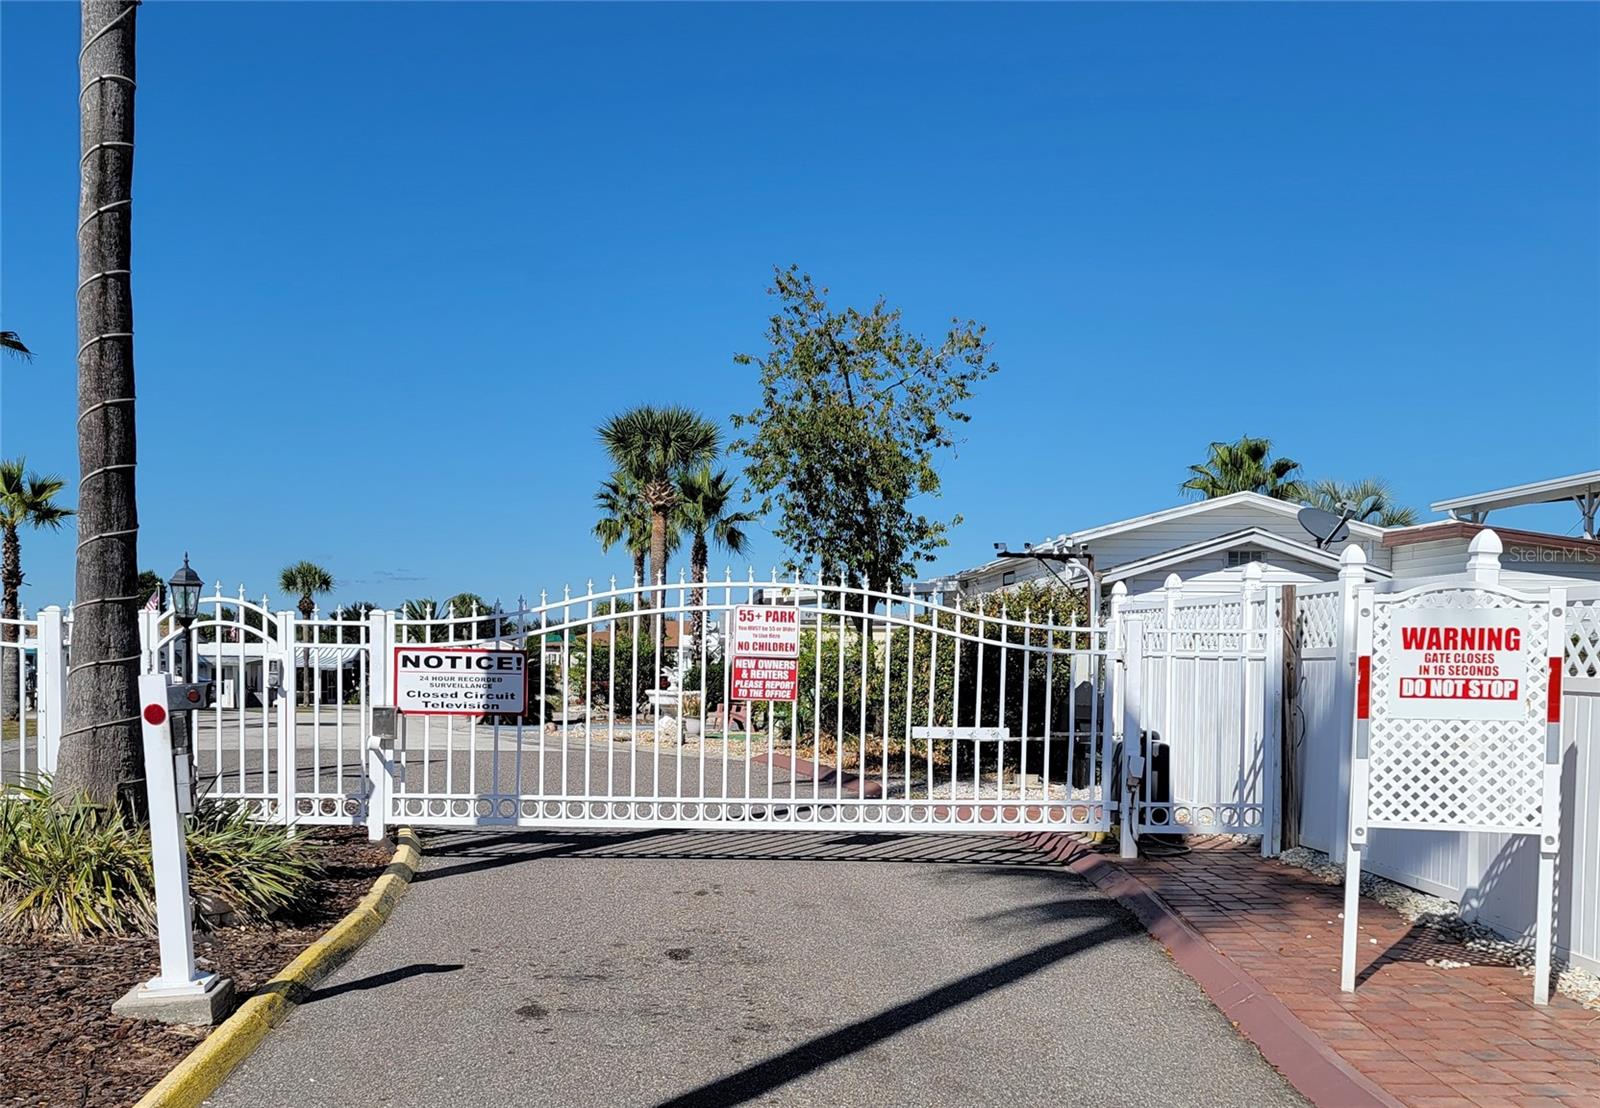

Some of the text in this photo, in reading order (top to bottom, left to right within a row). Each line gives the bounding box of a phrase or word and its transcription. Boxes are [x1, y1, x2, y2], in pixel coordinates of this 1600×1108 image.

[739, 610, 762, 622] 55+
[765, 610, 795, 623] PARK
[1402, 627, 1520, 651] WARNING
[738, 641, 796, 652] NO CHILDREN
[402, 655, 522, 670] NOTICE!
[1424, 652, 1495, 664] GATE CLOSES
[736, 659, 796, 670] NEW OWNERS
[741, 670, 789, 680] & RENTERS
[1419, 665, 1500, 676] IN 16 SECONDS
[735, 680, 794, 690] PLEASE REPORT
[1402, 679, 1516, 698] DO NOT STOP
[406, 690, 516, 700] Closed Circuit
[738, 689, 748, 697] TO
[765, 690, 792, 698] OFFICE
[422, 701, 500, 710] Television
